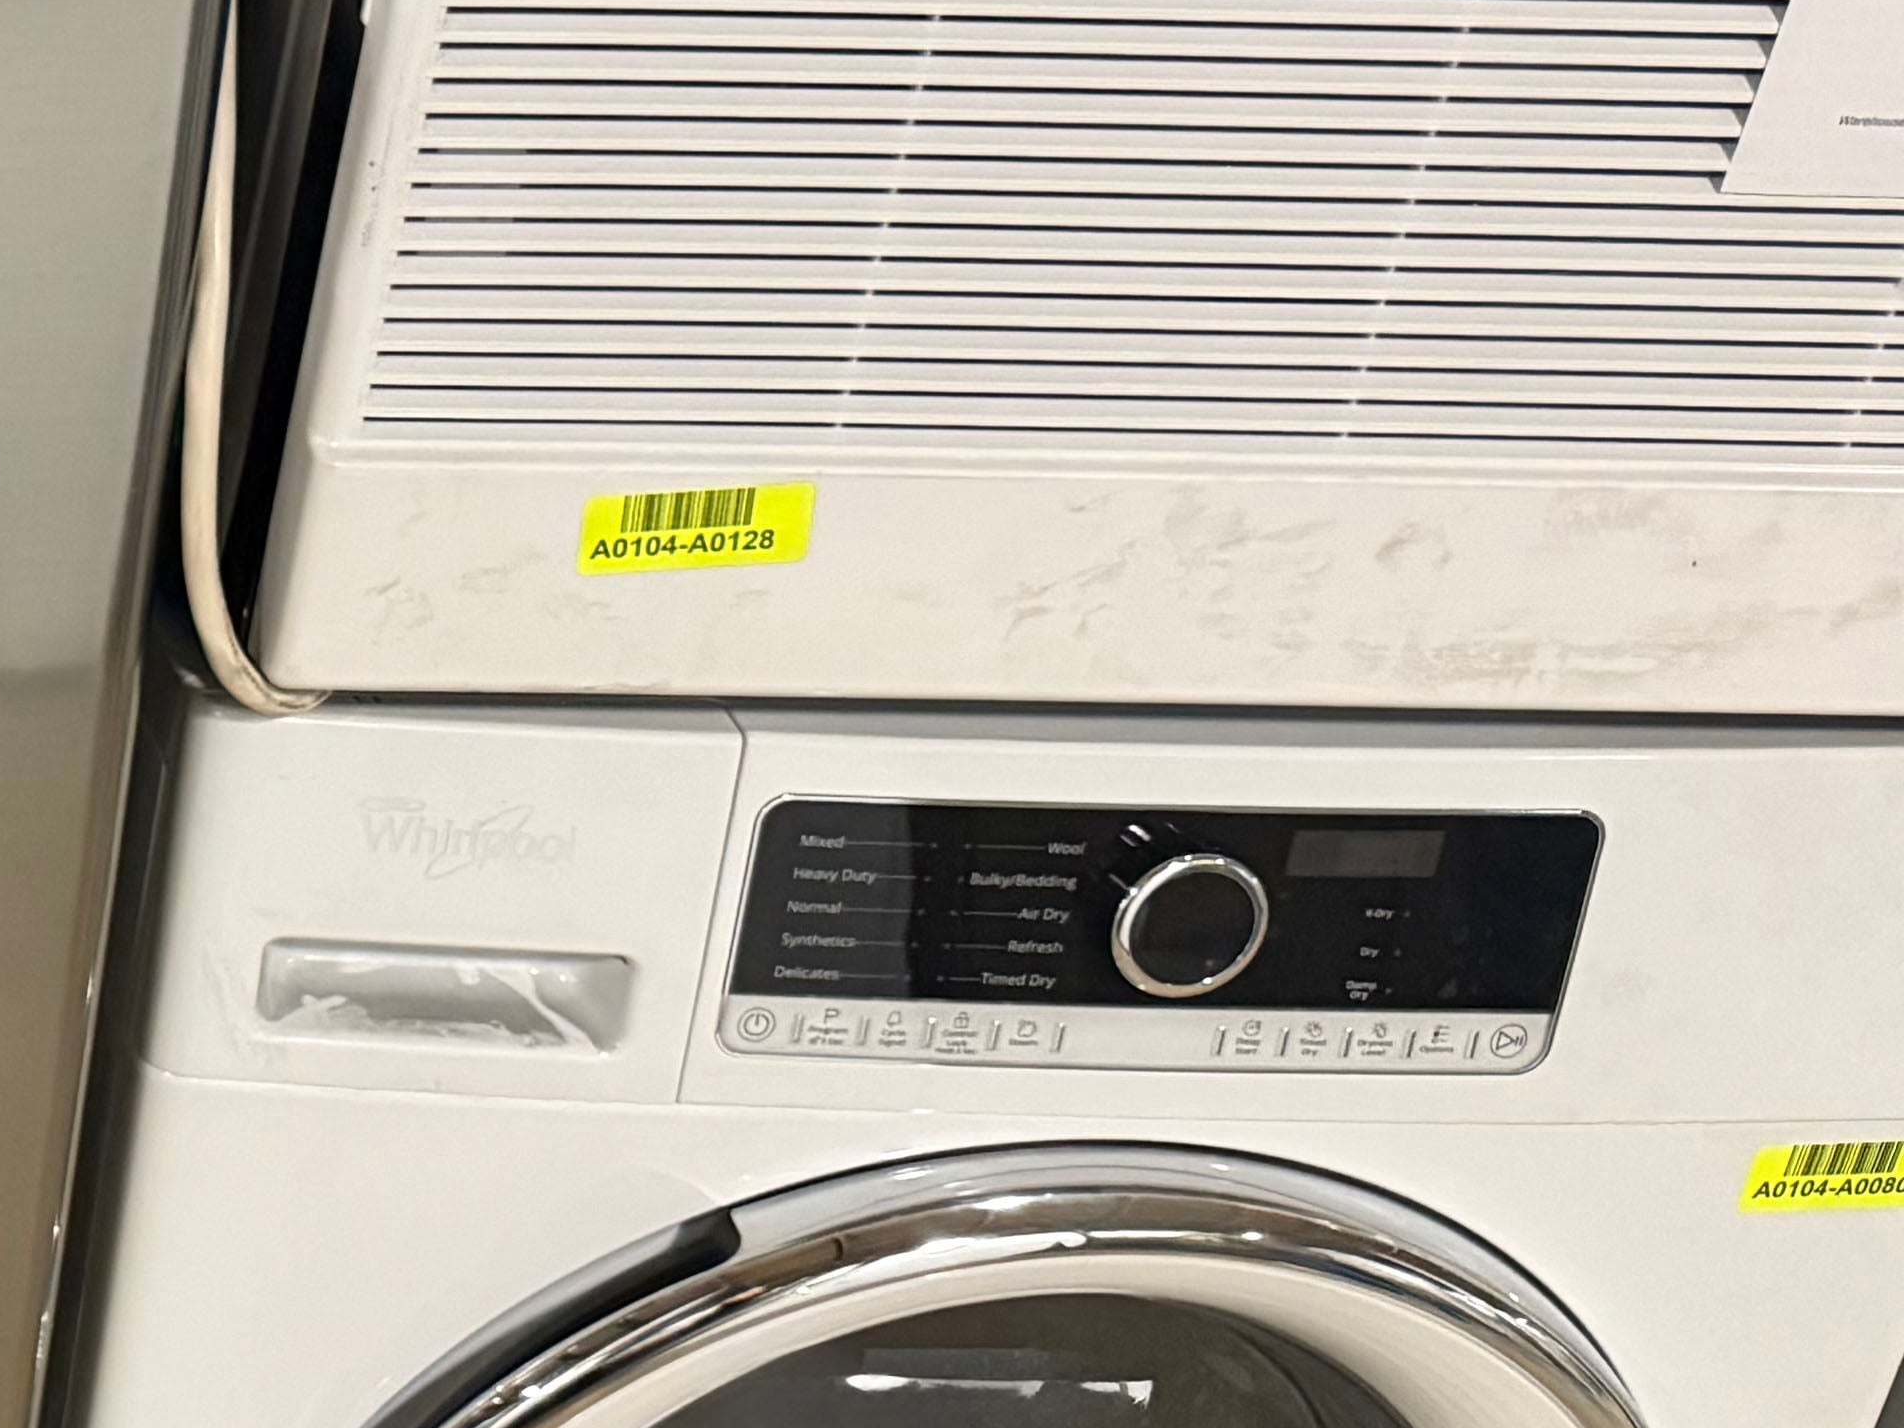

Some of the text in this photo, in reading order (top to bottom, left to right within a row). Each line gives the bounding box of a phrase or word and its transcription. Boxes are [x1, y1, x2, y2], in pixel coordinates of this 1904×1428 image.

[590, 529, 775, 560] A0104-A0128
[800, 835, 845, 849] Mixed
[1048, 842, 1086, 856] Wool
[793, 867, 878, 885] Heavy Duty
[970, 873, 1078, 891] Bulky/Bedding
[787, 901, 842, 914] Normal
[1017, 909, 1071, 923] Air Dry
[782, 932, 856, 948] Synthetics
[1008, 940, 1063, 954] Refresh
[774, 966, 840, 981] Delicates
[981, 973, 1056, 990] Timed Dry
